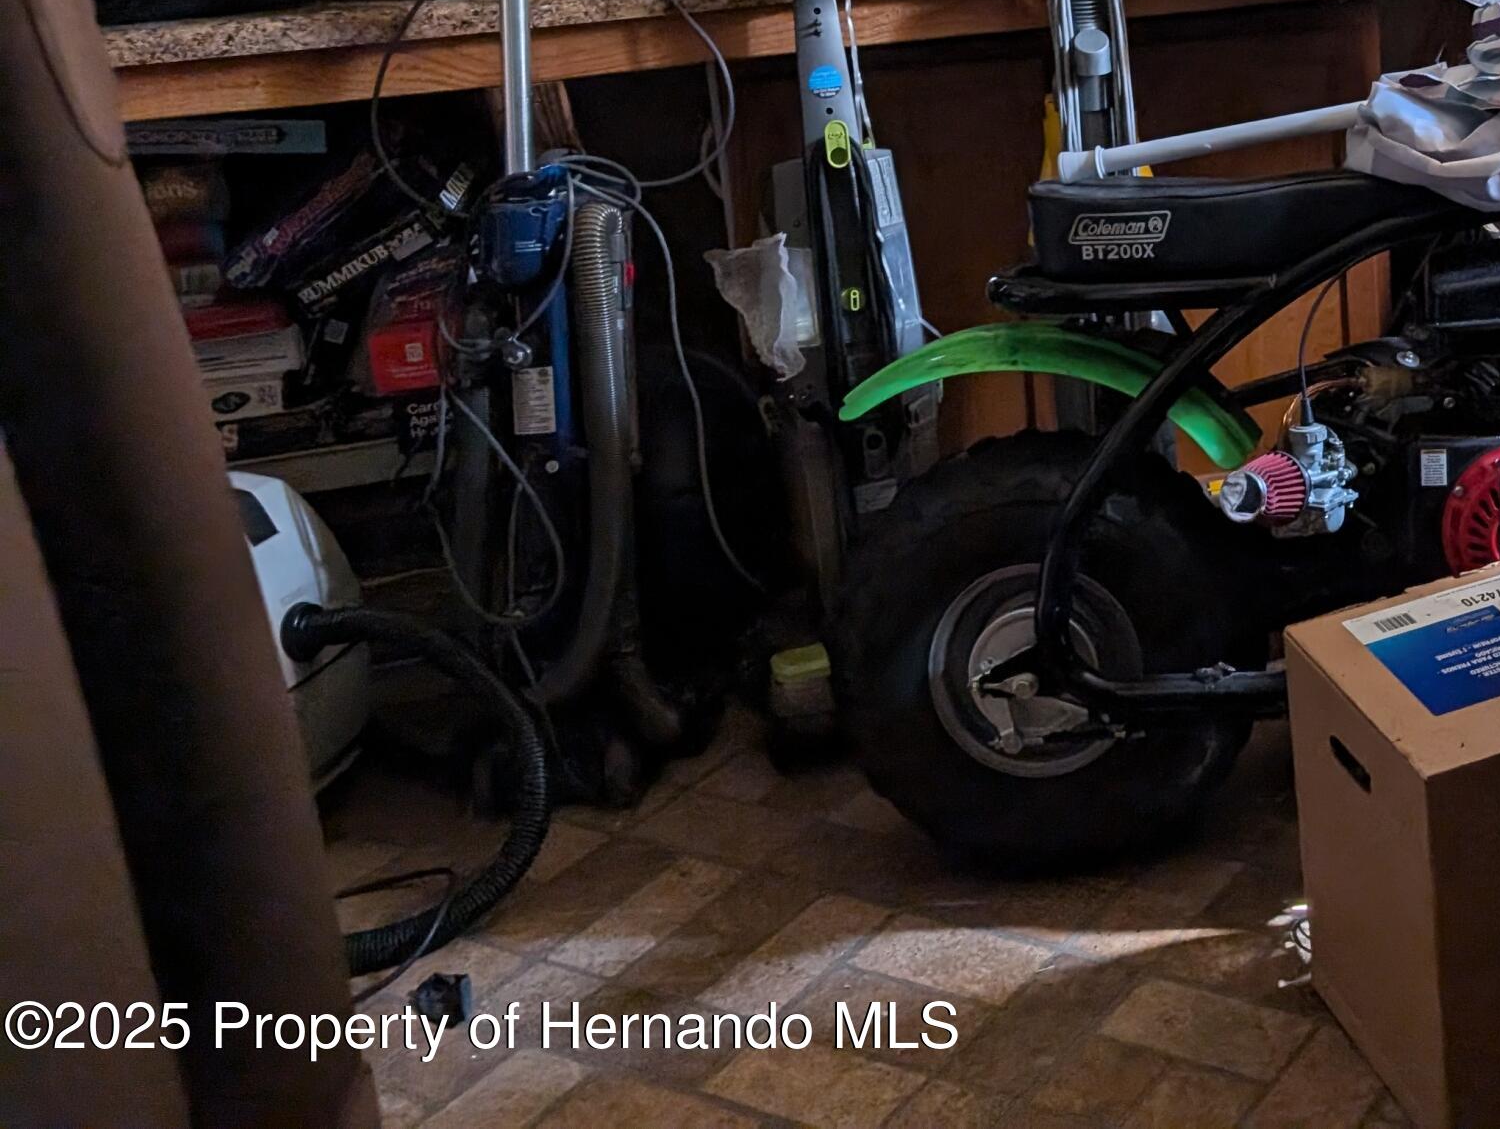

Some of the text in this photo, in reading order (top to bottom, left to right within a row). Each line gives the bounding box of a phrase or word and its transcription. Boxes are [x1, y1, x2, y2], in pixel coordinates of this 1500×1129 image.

[1077, 218, 1147, 236] Coleman
[1081, 243, 1155, 260] BT200X
[297, 244, 389, 304] RUMMIKUB
